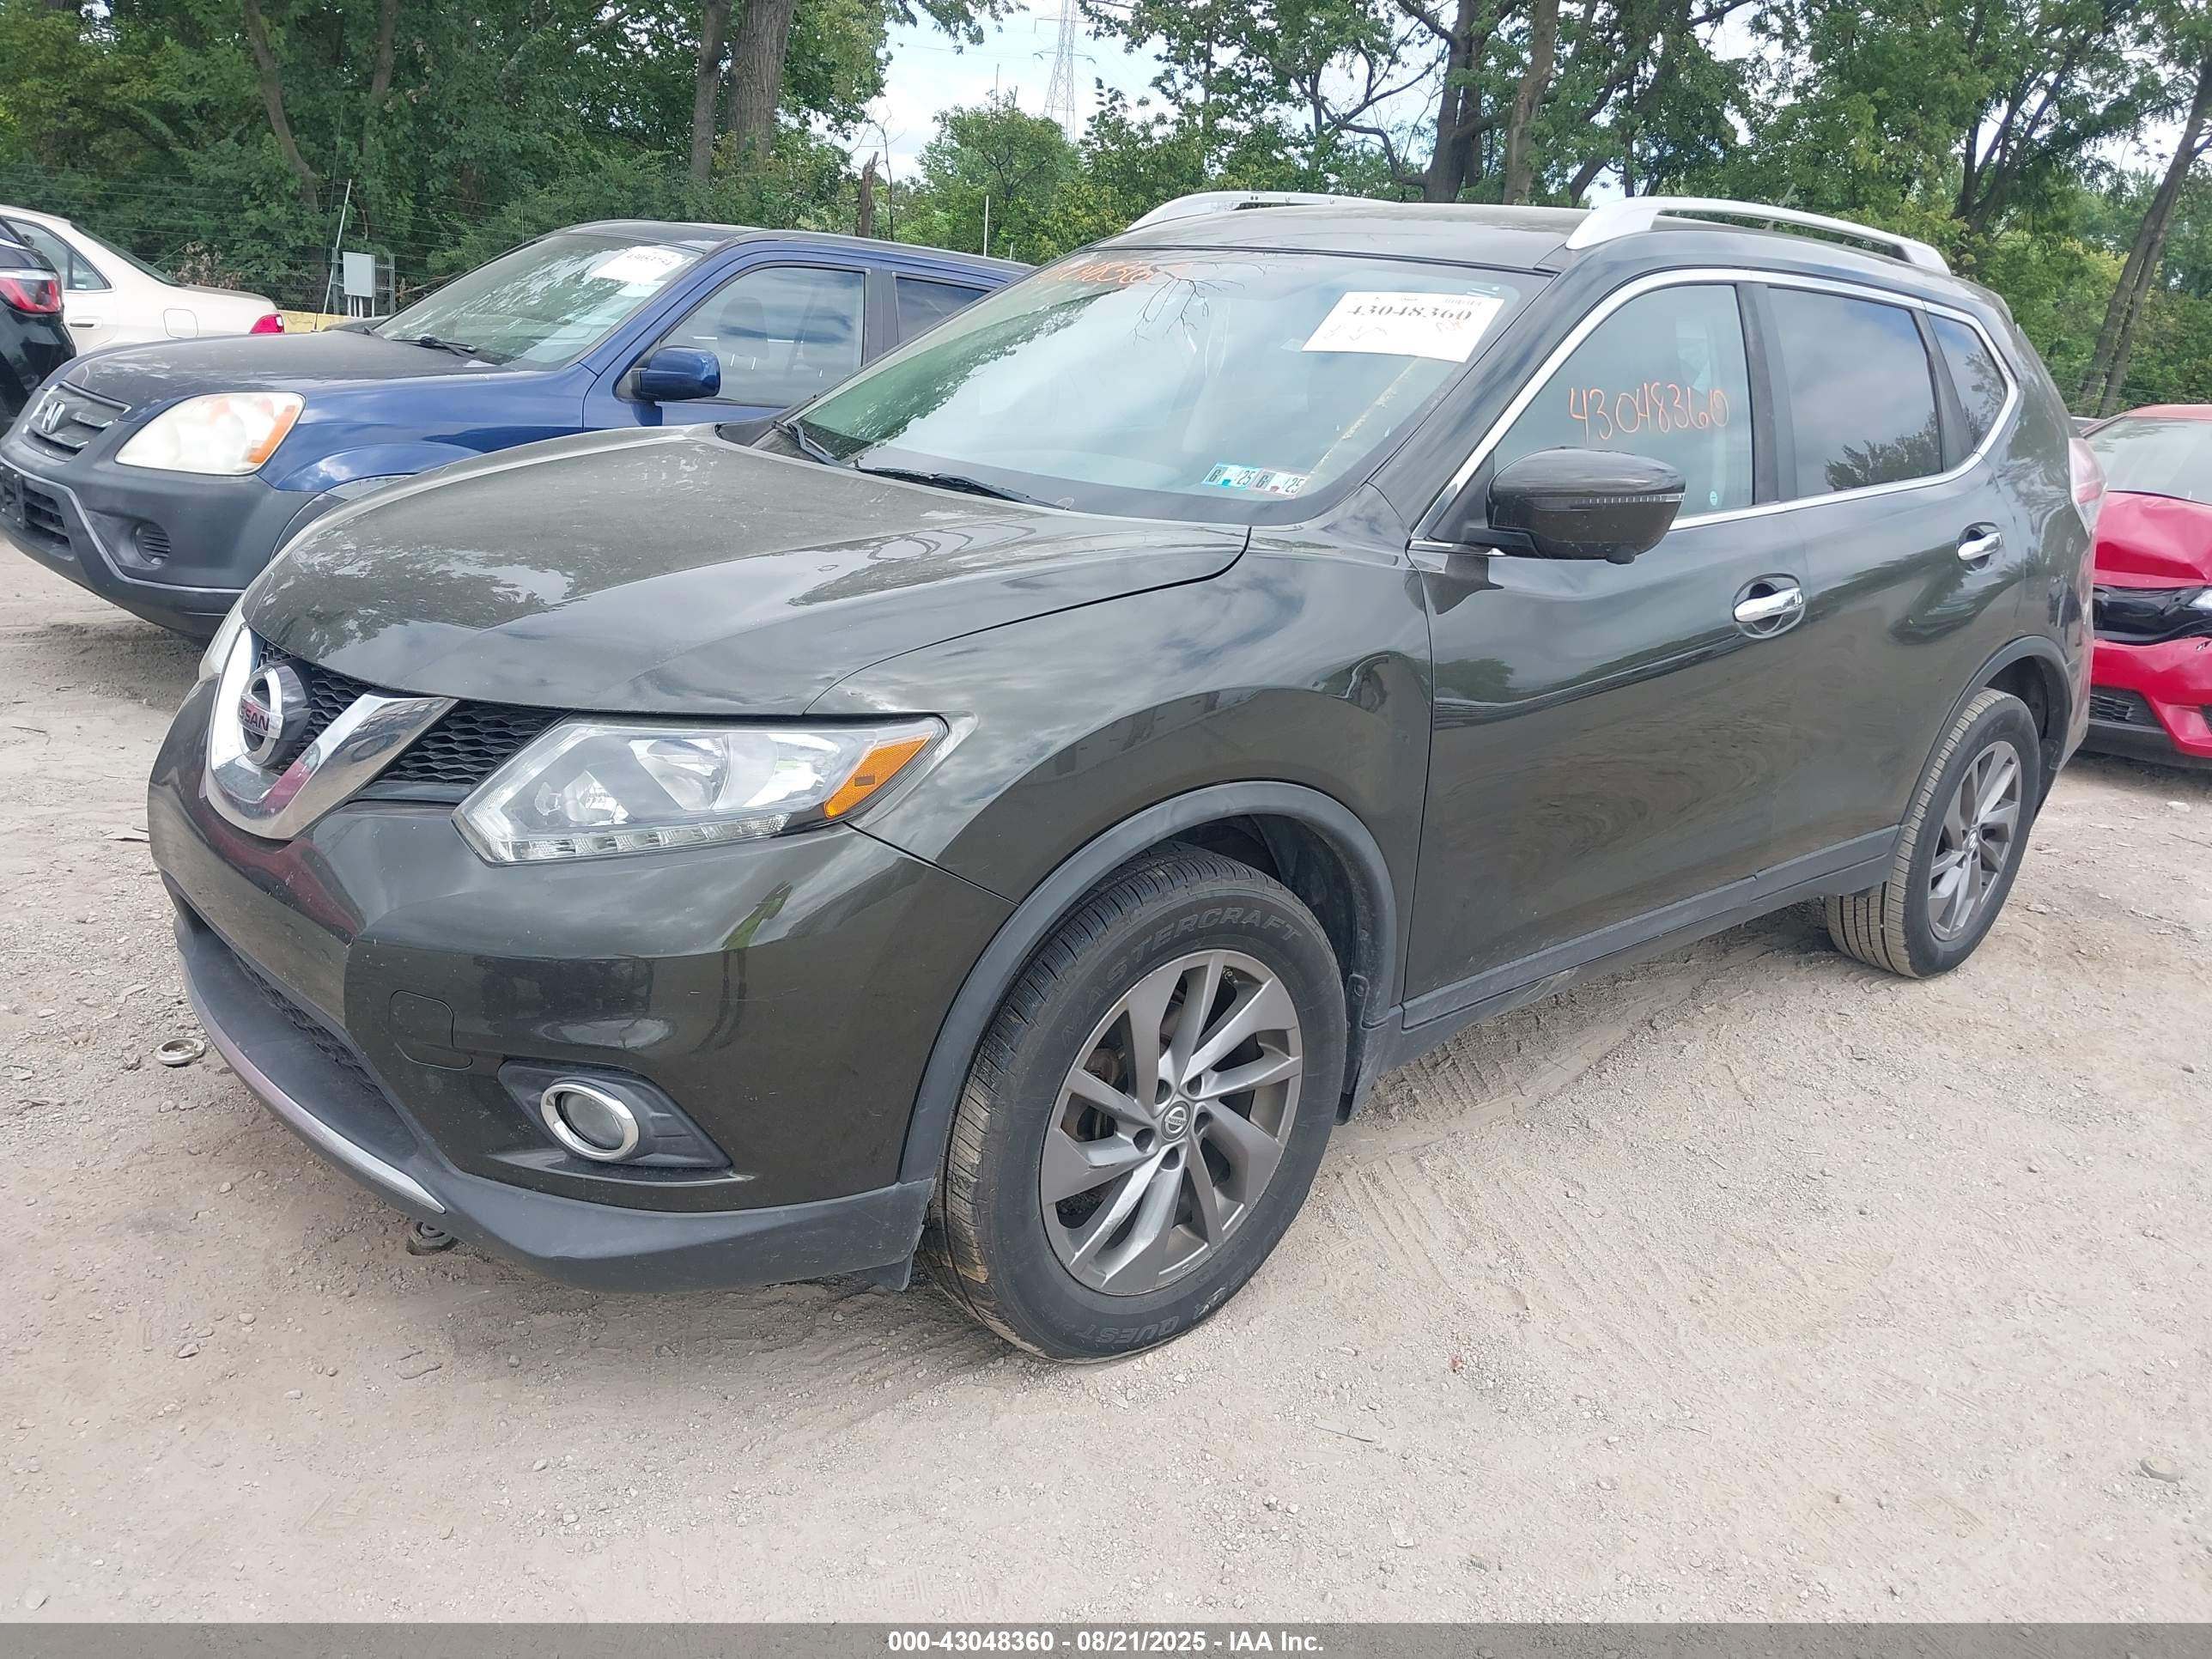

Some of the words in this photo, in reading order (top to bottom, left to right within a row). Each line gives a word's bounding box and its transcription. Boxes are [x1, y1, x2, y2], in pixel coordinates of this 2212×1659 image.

[1346, 304, 1473, 321] 43048360
[1568, 381, 1729, 444] 43048360
[1074, 1314, 1181, 1342] QUEST
